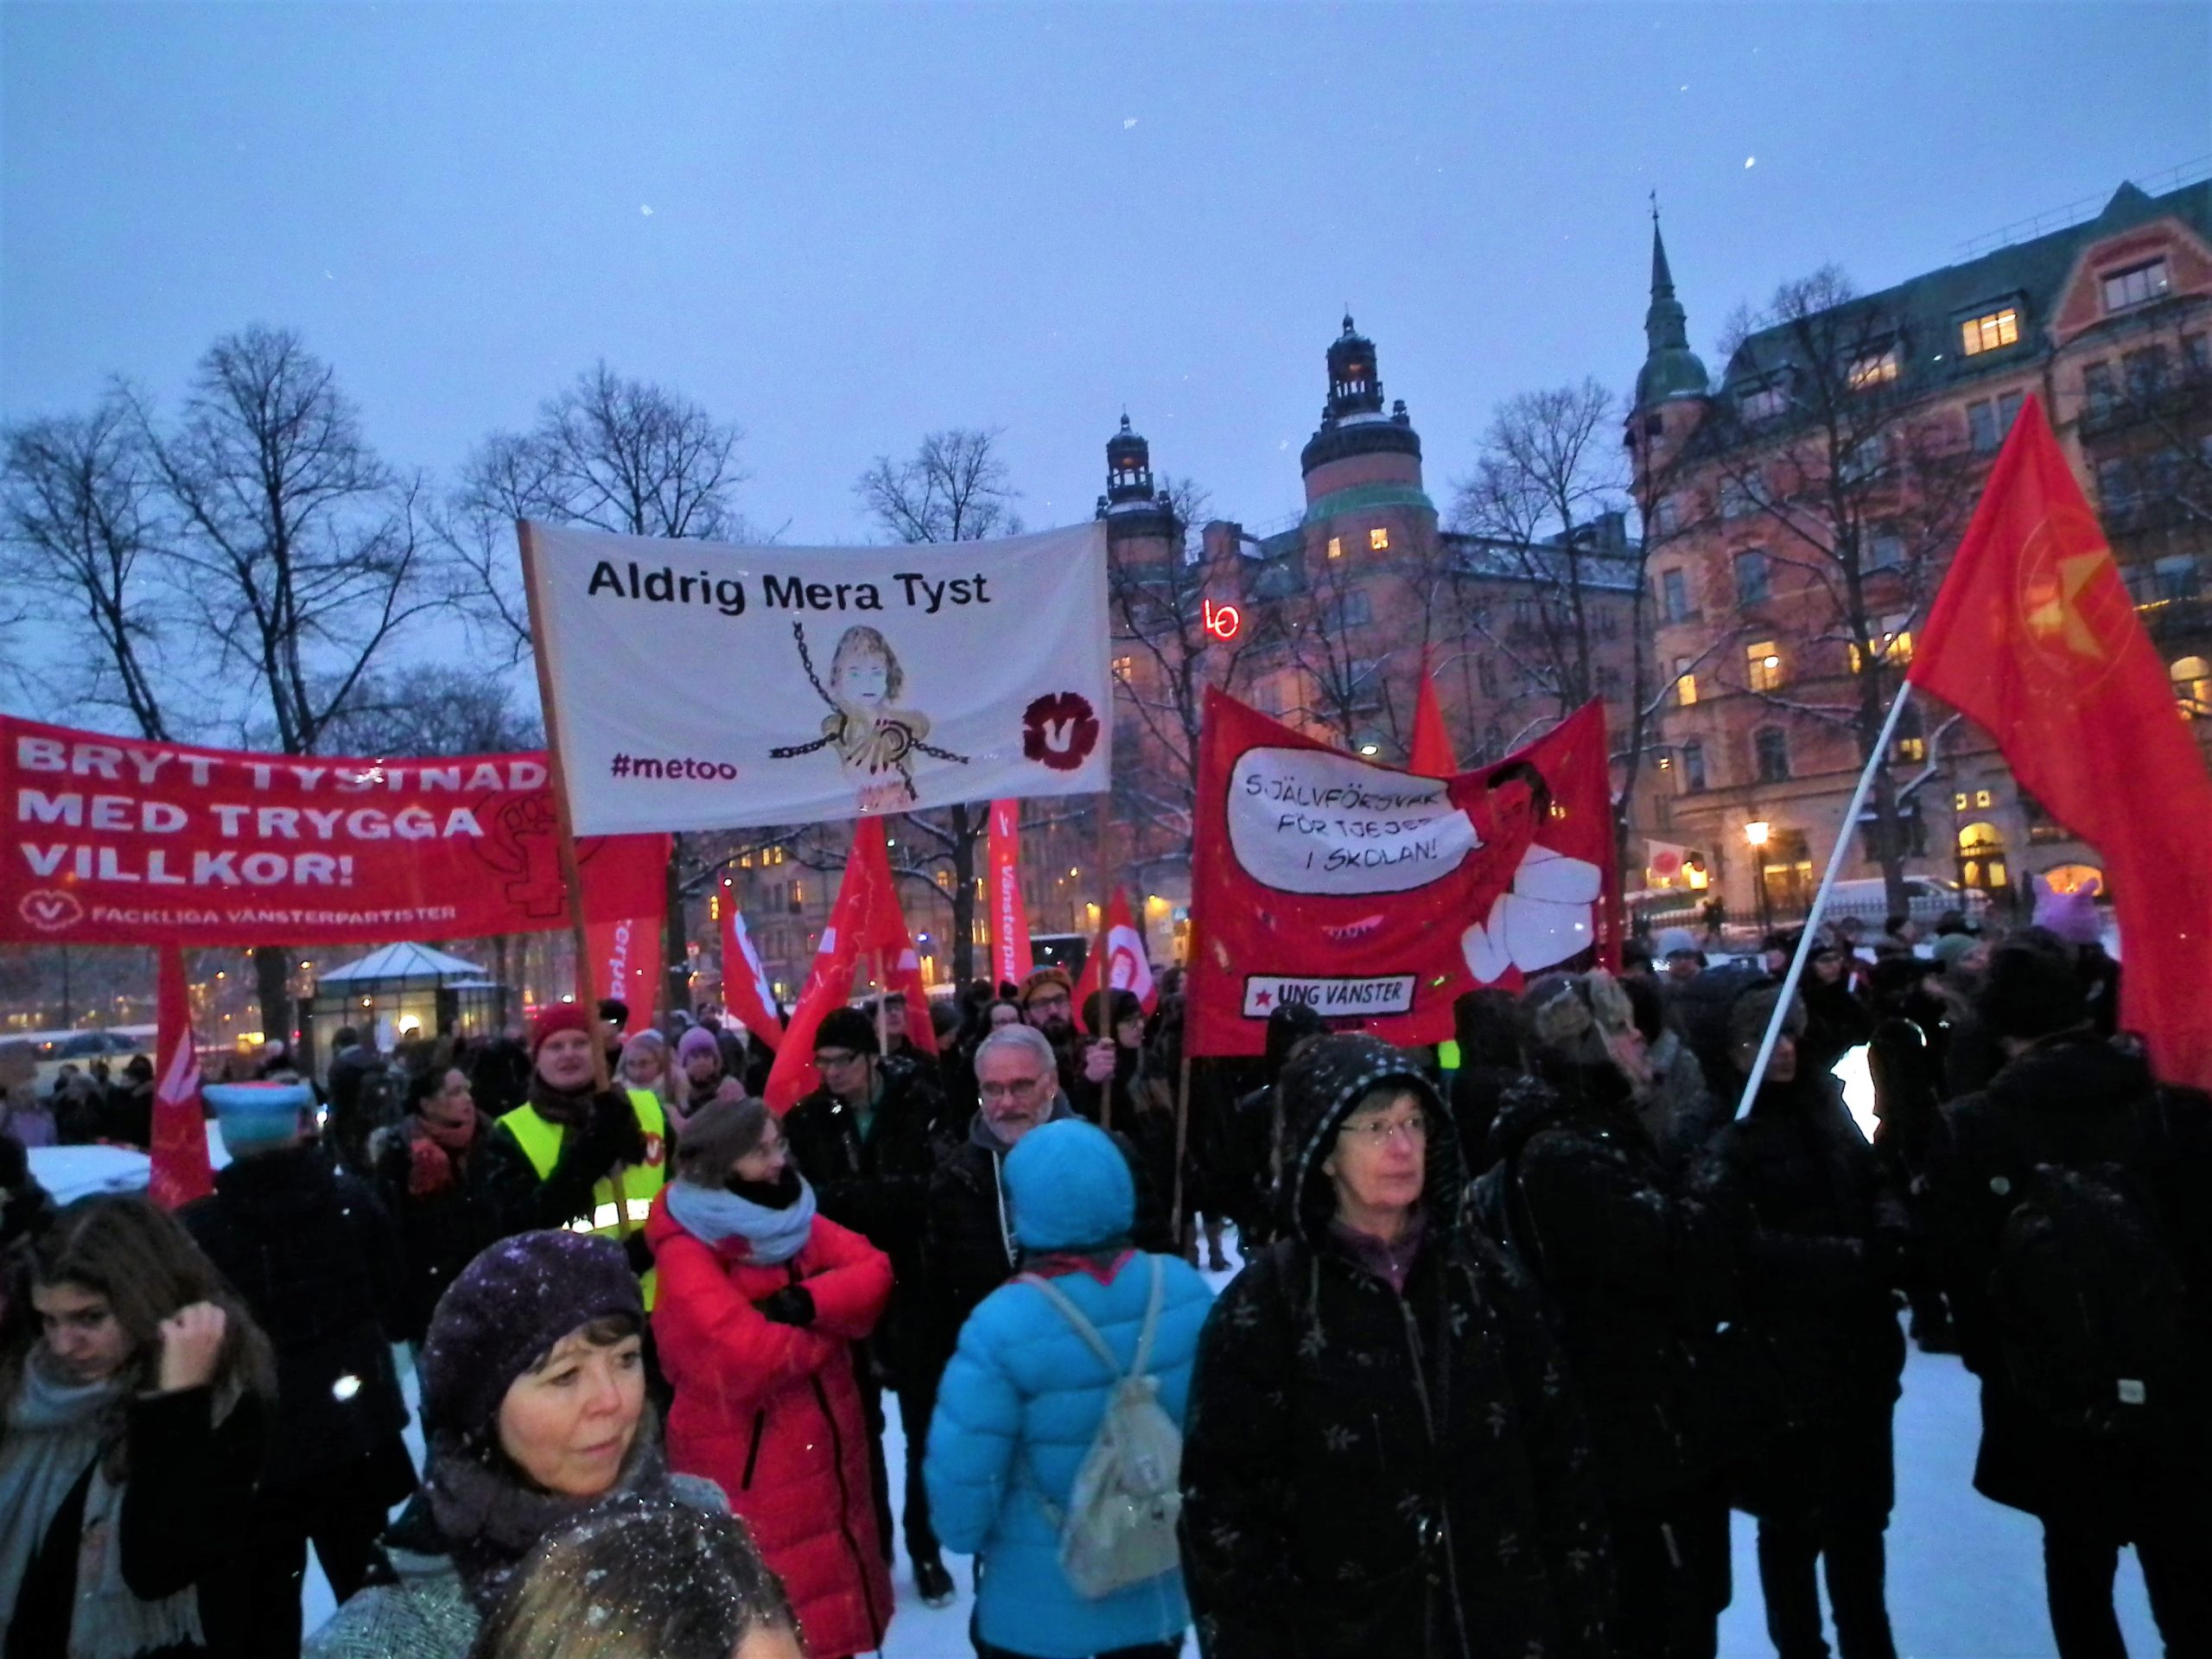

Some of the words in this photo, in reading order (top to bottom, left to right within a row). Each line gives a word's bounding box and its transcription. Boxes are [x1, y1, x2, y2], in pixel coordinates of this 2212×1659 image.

[588, 560, 747, 616] Aldrig
[762, 573, 883, 611] Mera
[893, 572, 991, 614] Tyst
[16, 735, 225, 787] BRYT
[240, 760, 554, 792] TYSTNAD
[610, 751, 738, 780] #metoo
[16, 788, 189, 834] MED
[209, 803, 485, 840] TRYGGA
[19, 842, 353, 887] VILLKOR!
[1323, 838, 1439, 872] SKOLAN!
[92, 906, 220, 925] FACKLIGA
[1001, 865, 1016, 984] Vänsterpar
[1278, 983, 1320, 1006] UNG
[1325, 979, 1403, 1006] VÄNSTER
